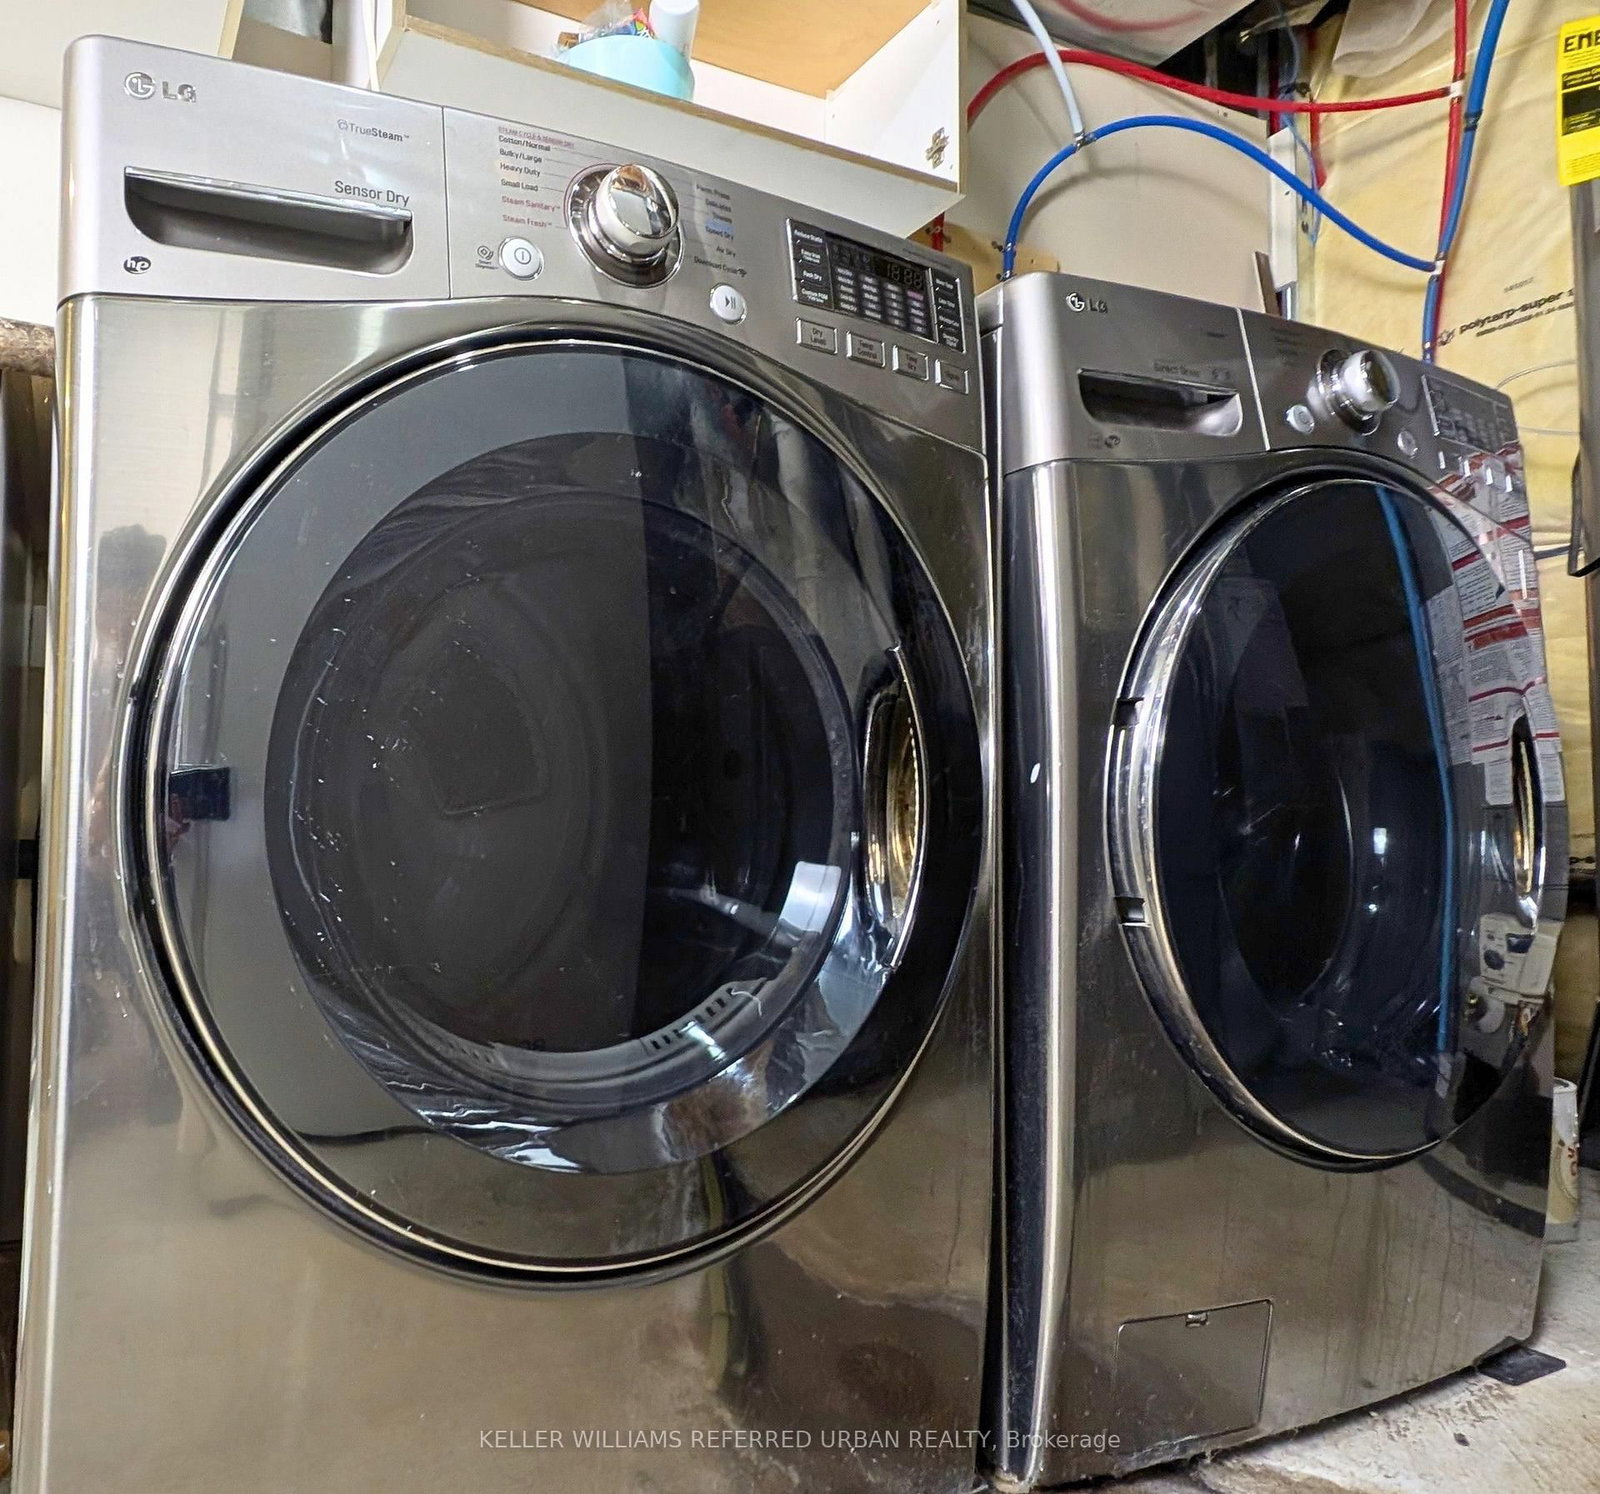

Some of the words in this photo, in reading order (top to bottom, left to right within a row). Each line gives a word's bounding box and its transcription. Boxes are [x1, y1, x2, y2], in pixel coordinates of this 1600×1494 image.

[162, 81, 197, 103] LG
[498, 135, 551, 152] Cotton/Normal
[499, 148, 542, 163] Bulky/Large
[500, 162, 522, 174] Heavy
[524, 166, 541, 177] Duty
[501, 179, 520, 188] Small
[521, 182, 539, 192] Load
[334, 180, 382, 200] Sensor
[386, 190, 410, 208] Dry
[501, 195, 524, 206] Steam
[502, 214, 526, 225] Steam
